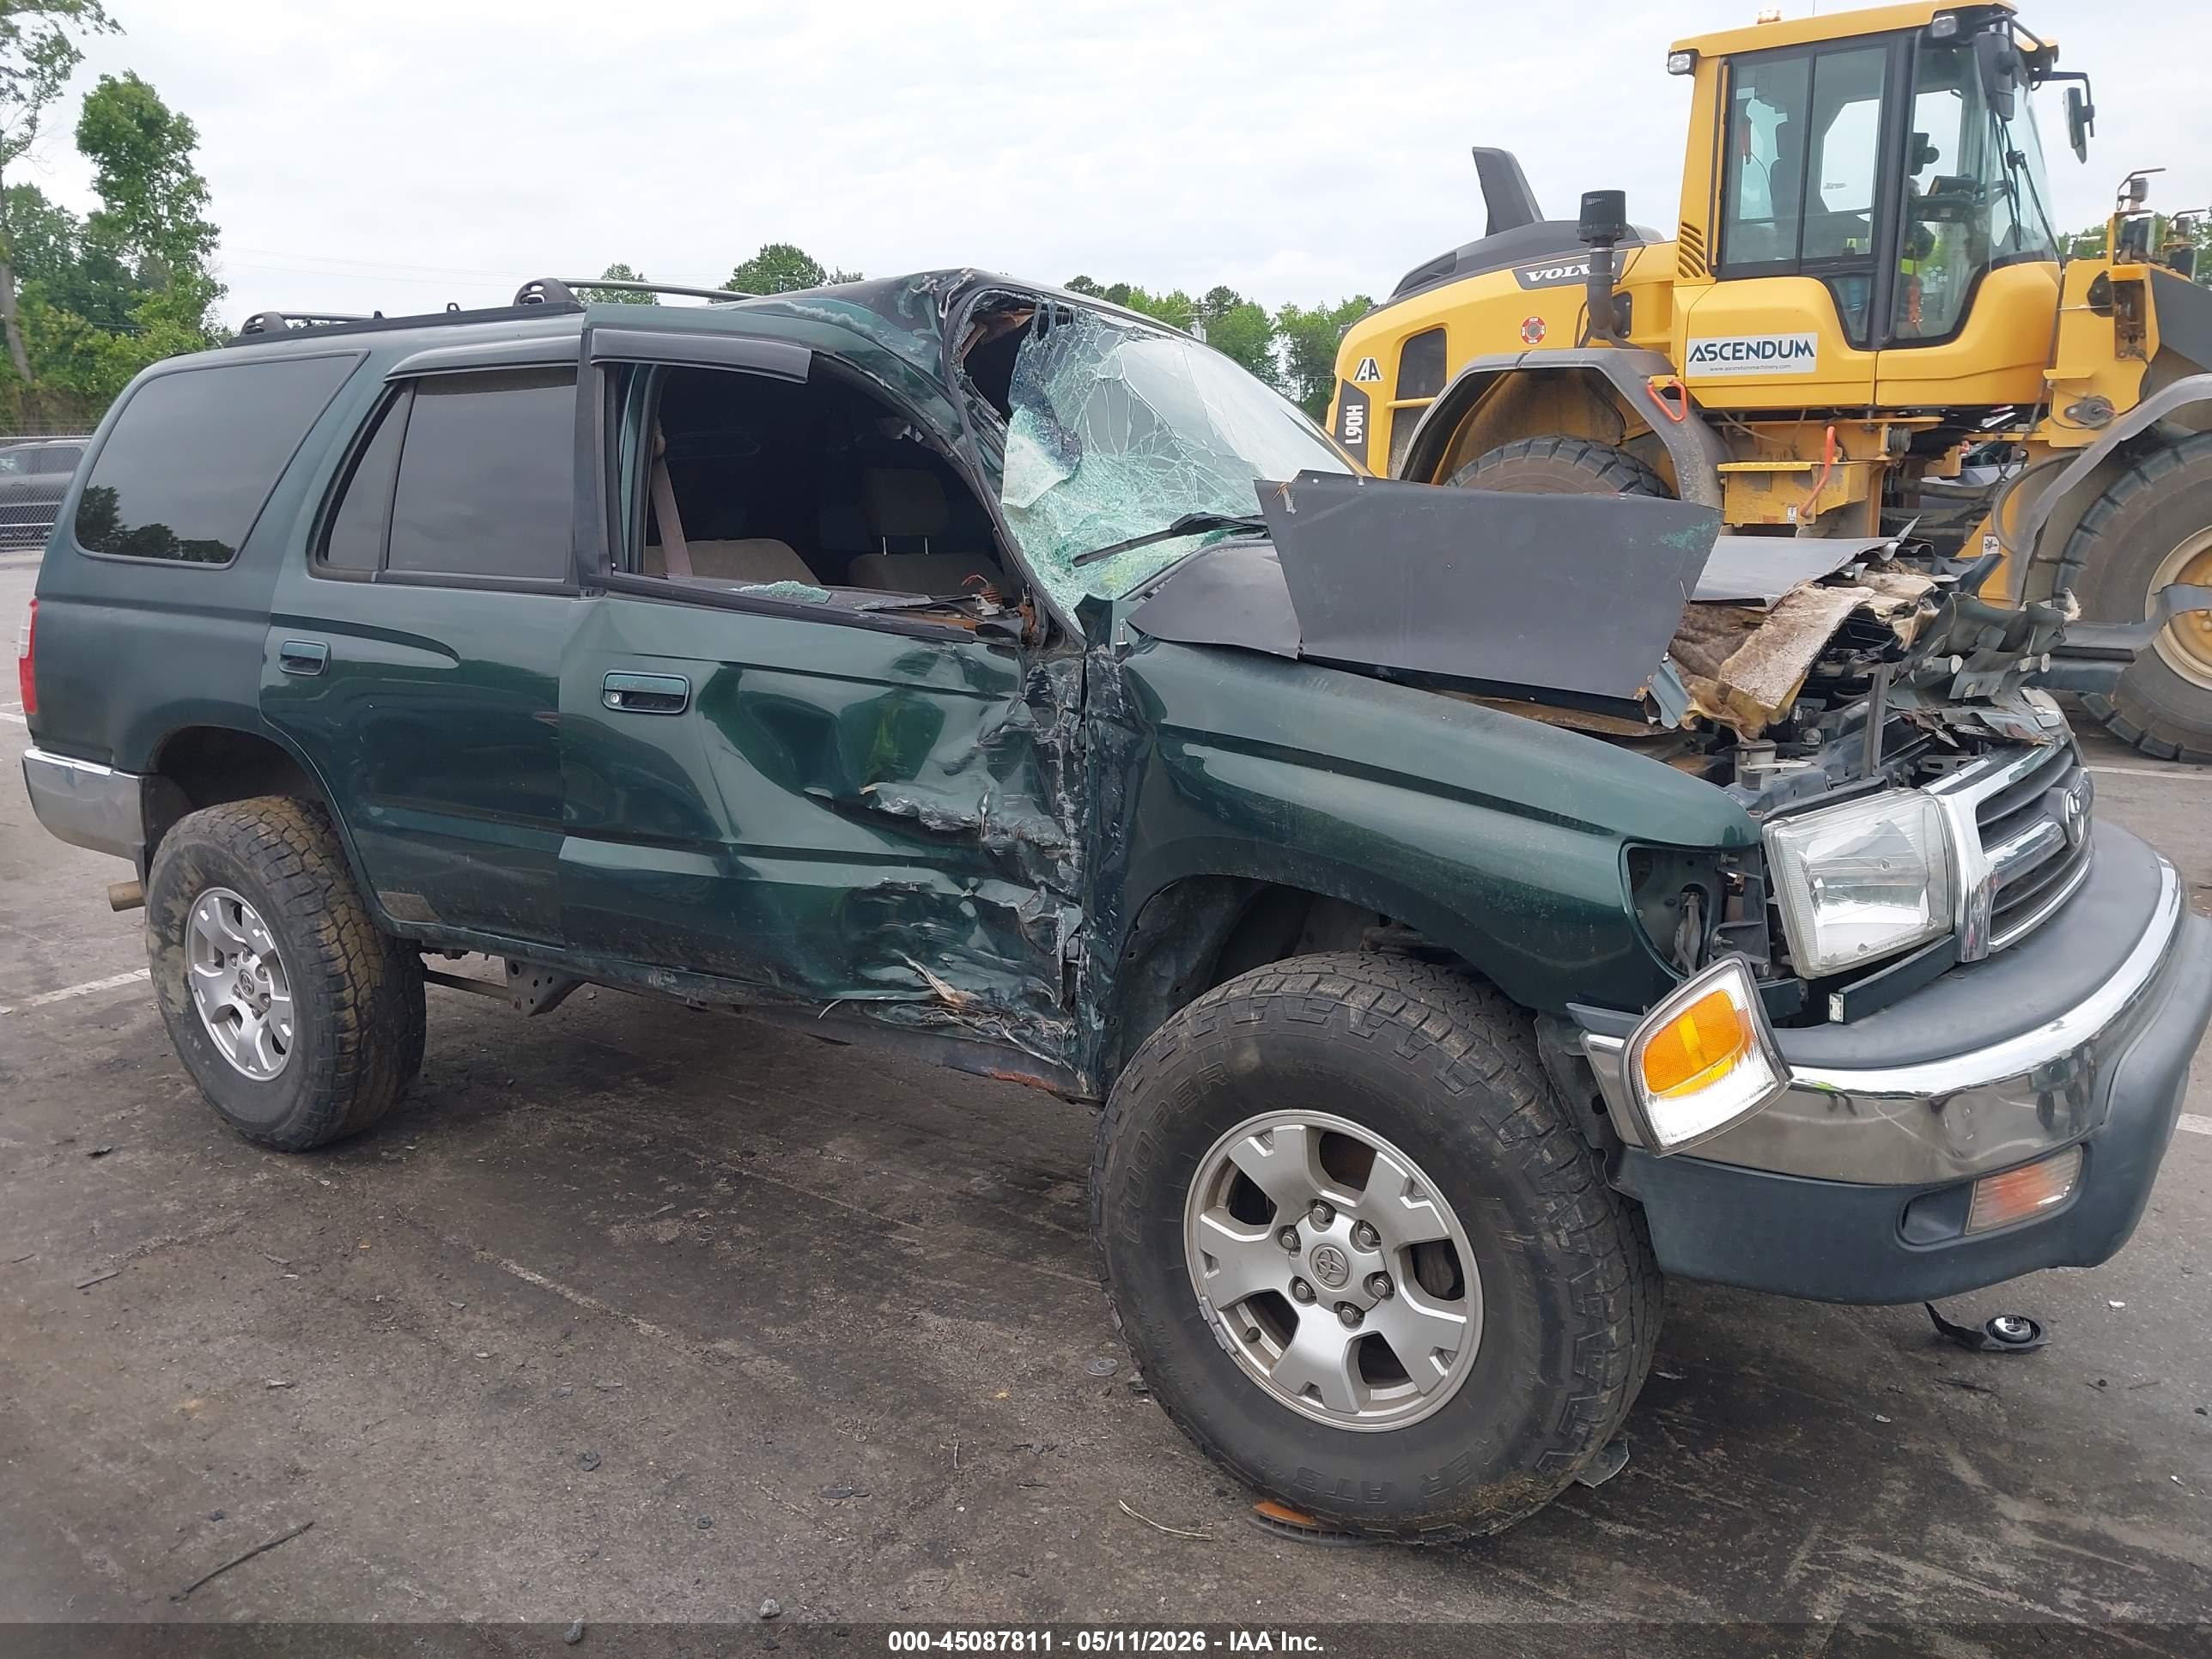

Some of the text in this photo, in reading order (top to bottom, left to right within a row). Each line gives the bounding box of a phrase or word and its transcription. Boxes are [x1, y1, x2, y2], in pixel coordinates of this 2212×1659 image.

[1526, 260, 1616, 283] VOLV
[1688, 337, 1815, 362] ASCENDUM
[1710, 363, 1791, 372] www.ascendummachinery.com
[1345, 404, 1364, 444] L90H
[1119, 1061, 1231, 1243] COOPER
